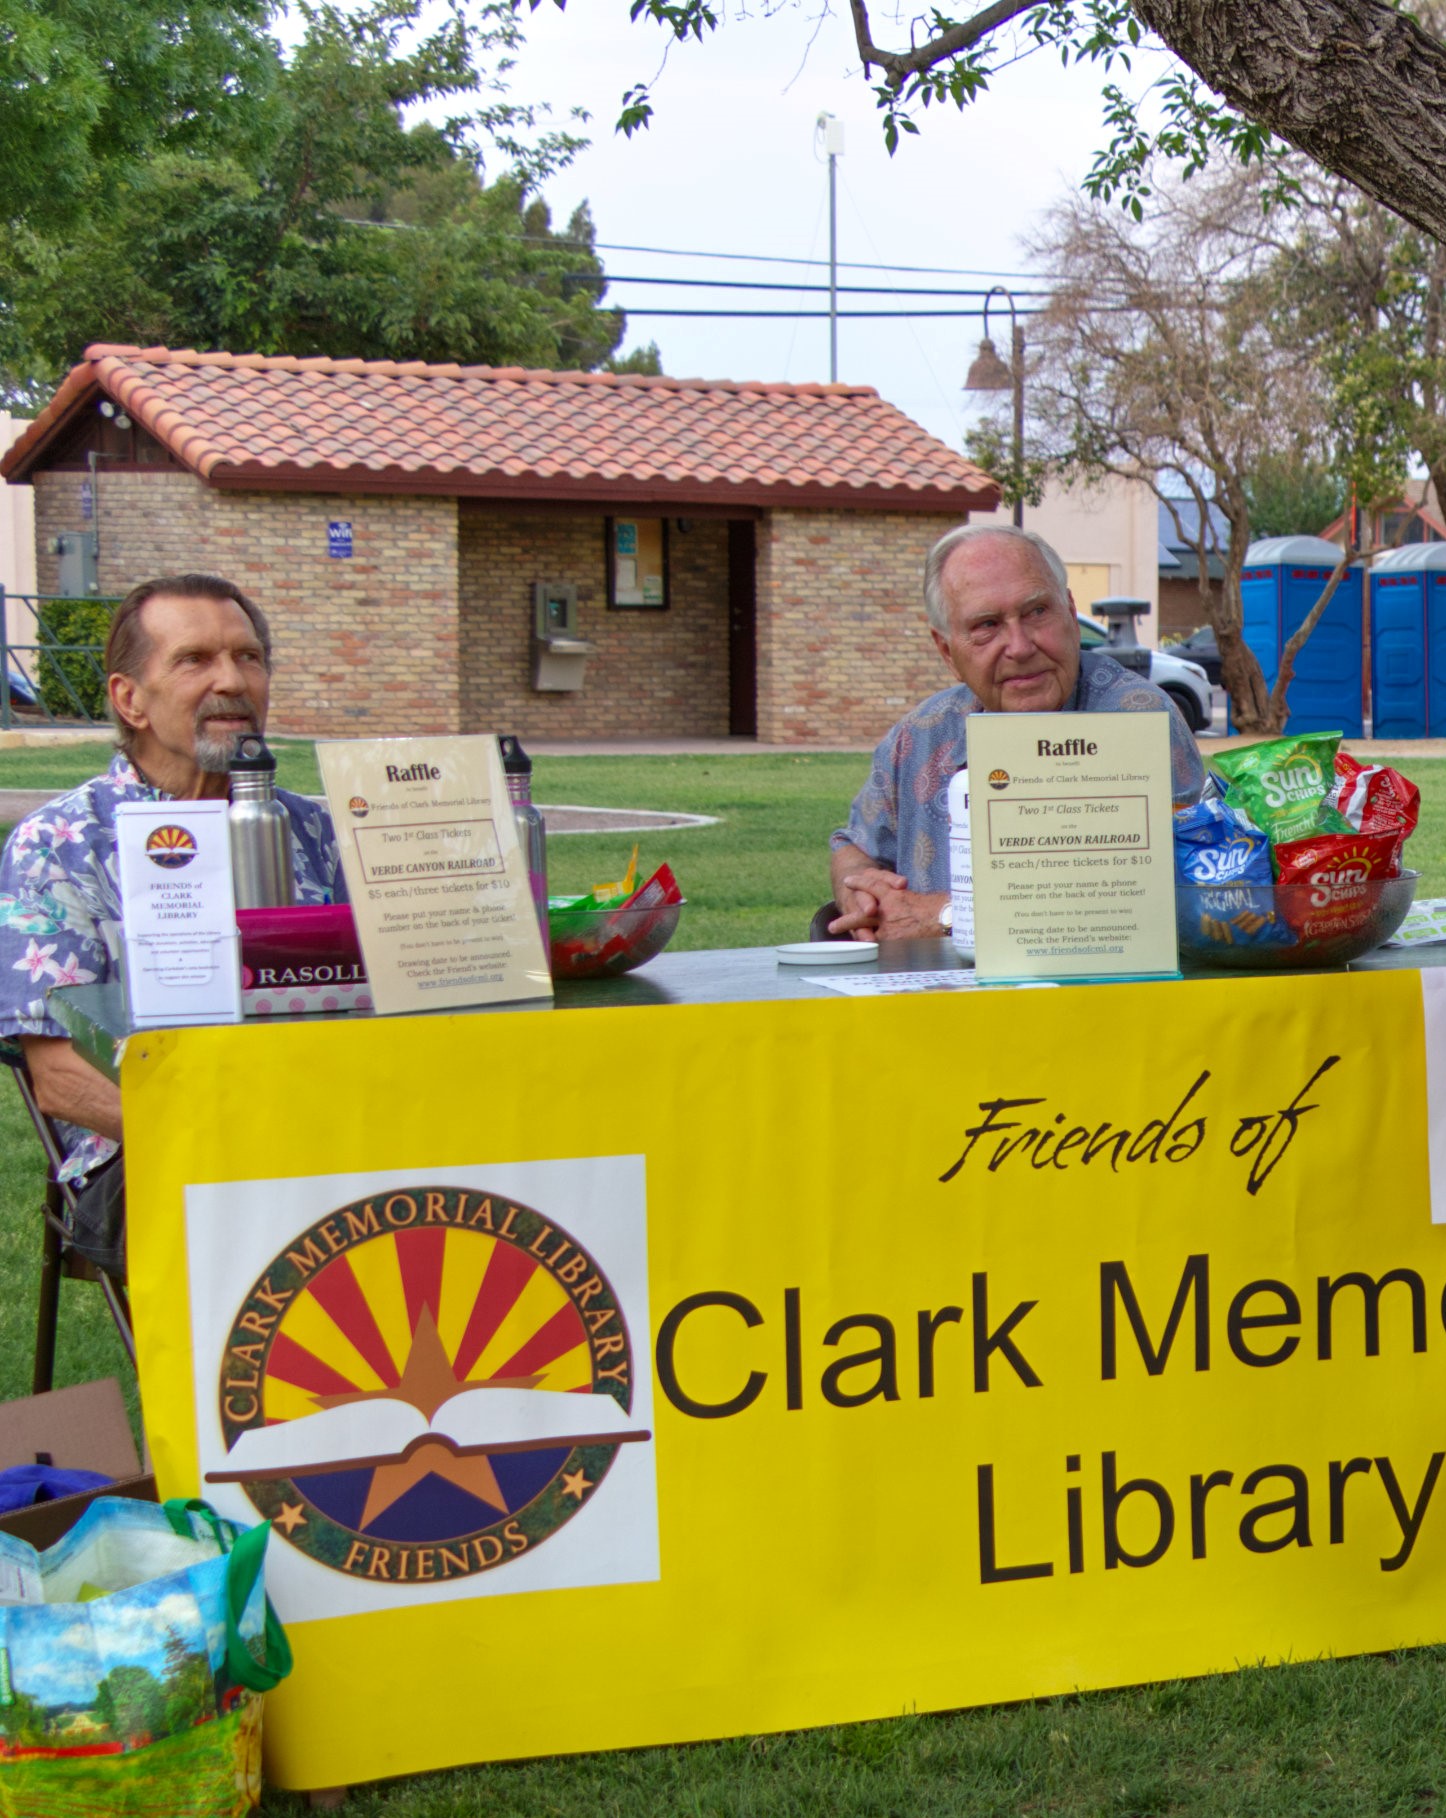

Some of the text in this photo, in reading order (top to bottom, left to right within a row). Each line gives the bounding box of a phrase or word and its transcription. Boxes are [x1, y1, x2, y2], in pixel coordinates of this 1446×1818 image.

[1037, 738, 1098, 756] Raffle
[386, 763, 441, 783] Raffle
[1012, 773, 1150, 784] Friends of Clark Memorial Library
[1261, 763, 1323, 807] Sun
[1287, 784, 1326, 802] CHIPS
[371, 797, 491, 811] Friends of Clark Memorial Library
[1018, 805, 1039, 815] Two
[1056, 804, 1082, 814] Class
[1084, 803, 1119, 813] Tickets
[382, 832, 401, 843] Two
[416, 830, 439, 841] Class
[441, 828, 471, 839] Tickets
[999, 833, 1141, 847] VERDE CANYON RAILROAD
[371, 858, 495, 876] VERDE CANYON RAILROAD
[990, 855, 1152, 870] $5 each/three tickets for $10
[1194, 848, 1248, 880] Sun
[150, 882, 192, 890] FRIENDS
[368, 879, 510, 899] $5 each/three tickets for $10
[1007, 879, 1138, 891] Please put your name & phone
[1310, 869, 1369, 908] Sun
[1331, 884, 1367, 901] CHIPS
[161, 892, 192, 900] CLARK
[999, 893, 1033, 901] number
[1048, 891, 1062, 899] the
[1065, 891, 1085, 899] back
[1088, 890, 1096, 898] of
[1098, 889, 1117, 899] your
[151, 901, 204, 910] MEMORIAL
[383, 912, 409, 921] Please
[412, 911, 426, 921] put
[428, 910, 446, 919] your
[481, 904, 505, 914] phone
[157, 911, 198, 919] LIBRARY
[378, 923, 410, 933] number
[413, 923, 423, 931] on
[425, 920, 438, 929] the
[440, 918, 459, 928] back
[461, 917, 470, 926] of
[471, 916, 489, 927] your
[1008, 927, 1044, 937] Drawing
[1046, 925, 1065, 934] date
[1067, 925, 1075, 933] to
[1077, 924, 1088, 933] be
[1016, 936, 1043, 945] Check
[1046, 935, 1060, 944] the
[1062, 934, 1096, 943] Friend's
[397, 958, 430, 969] Drawing
[431, 956, 447, 965] date
[450, 955, 457, 963] to
[459, 953, 468, 962] be
[406, 968, 431, 978] Check
[433, 967, 445, 976] the
[938, 1054, 1342, 1197] Friends of
[226, 1192, 630, 1422] CLARK MEMORIAL LIBRARY
[655, 1271, 1044, 1420] Clark
[976, 1450, 1446, 1585] Library
[343, 1521, 529, 1579] FRIENDS
